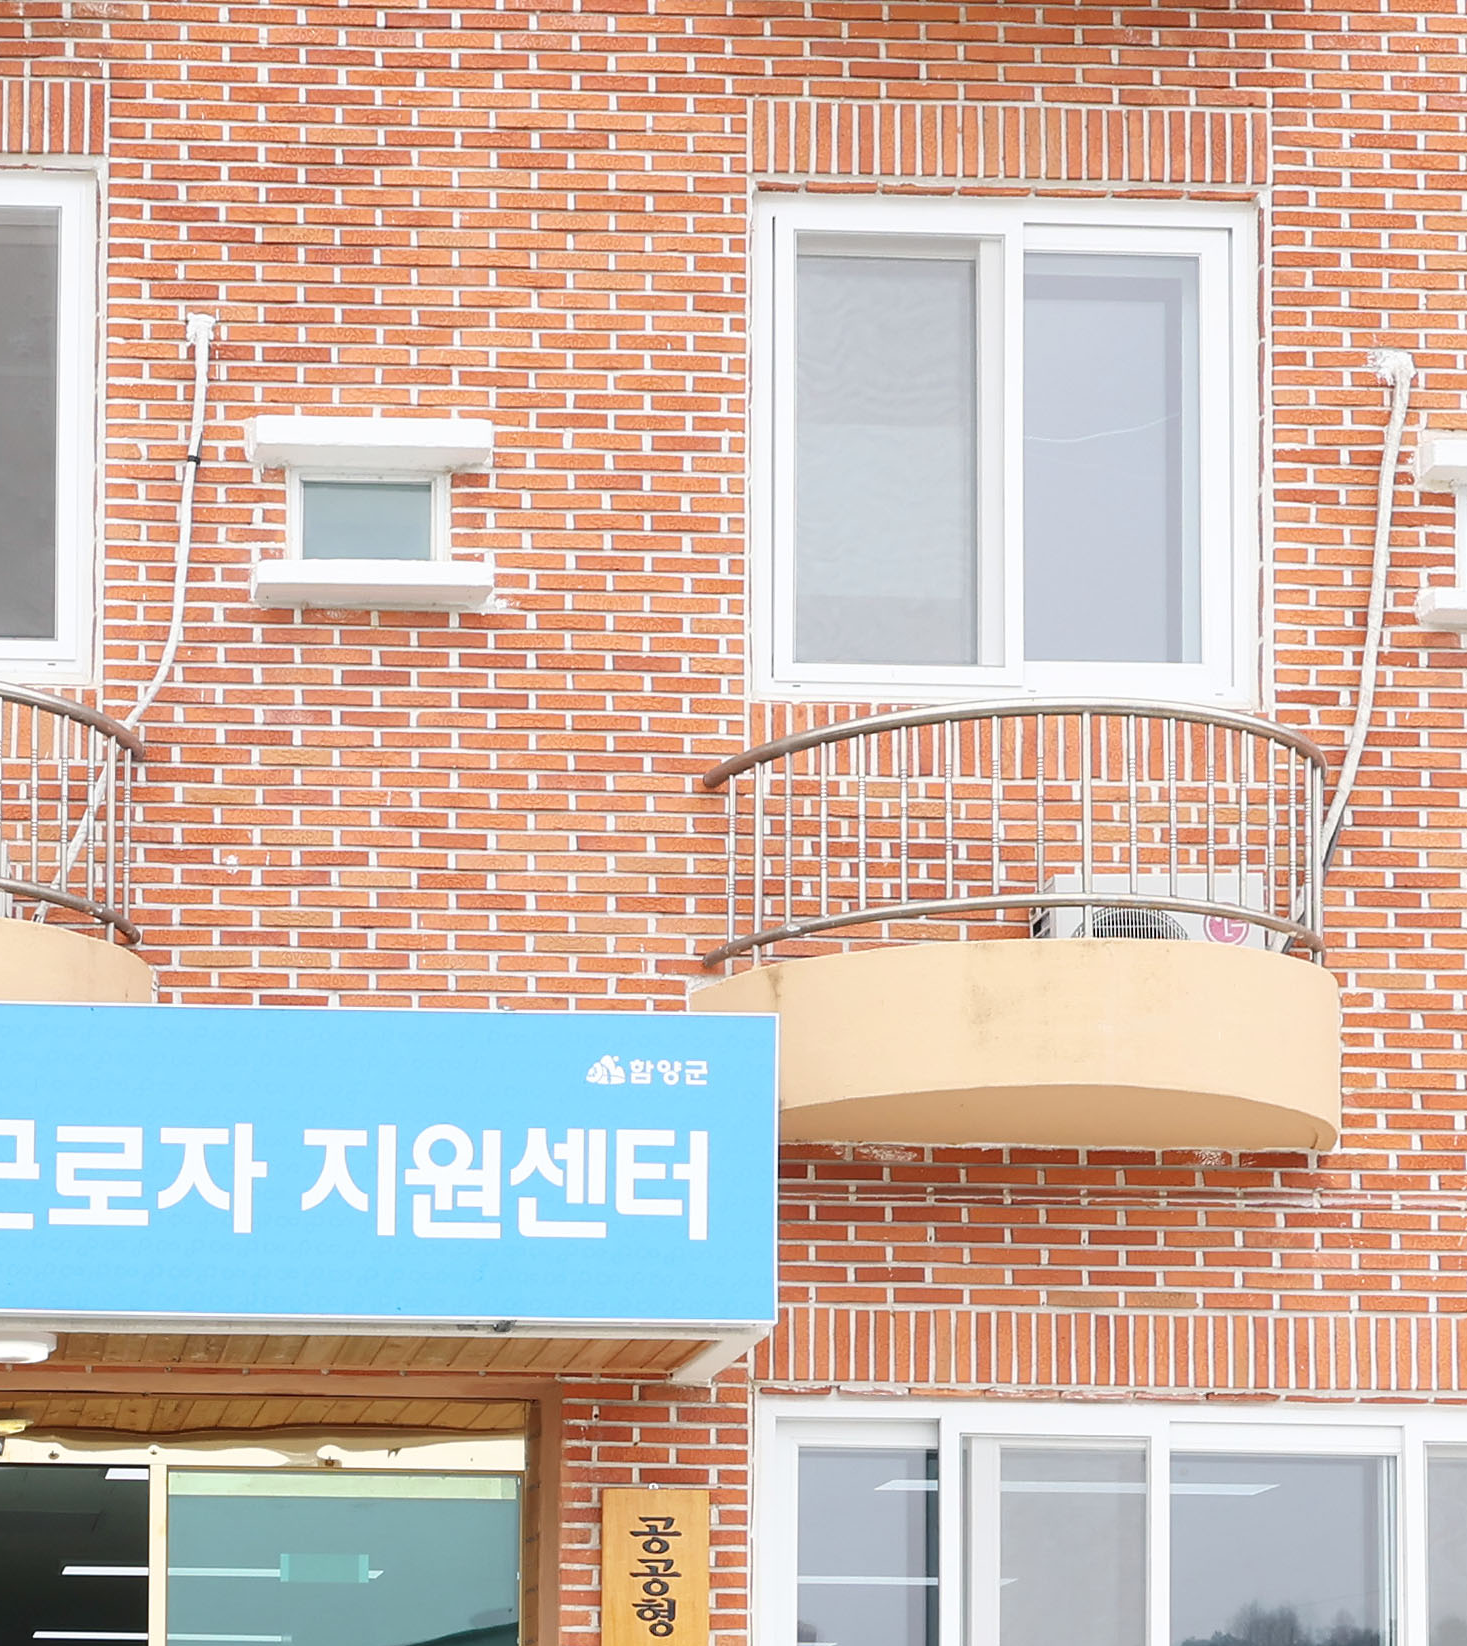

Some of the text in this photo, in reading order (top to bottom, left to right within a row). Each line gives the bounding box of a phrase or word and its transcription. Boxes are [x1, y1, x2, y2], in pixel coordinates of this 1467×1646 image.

[629, 1059, 709, 1086] 함양군
[302, 1124, 708, 1240] 지원센터
[629, 1515, 682, 1638] 공공형
